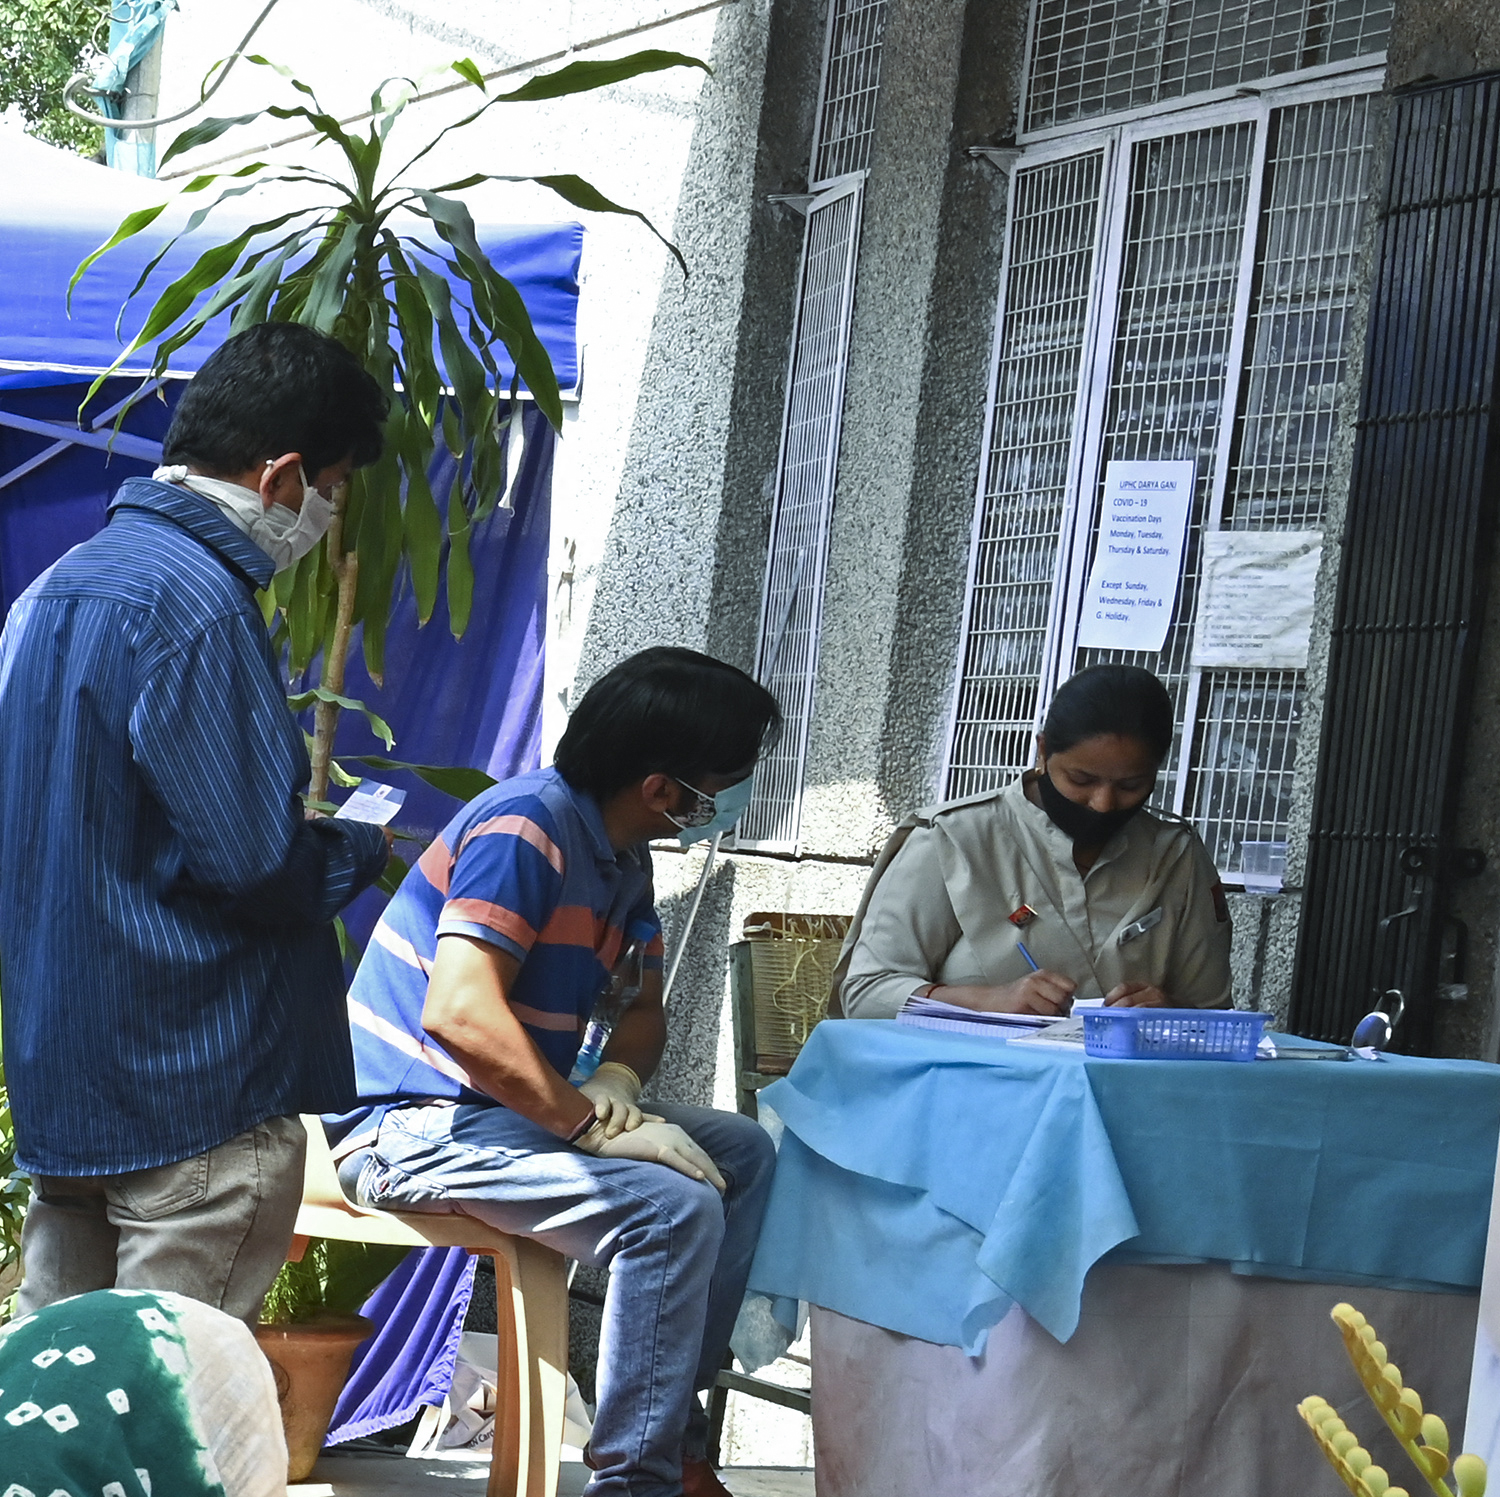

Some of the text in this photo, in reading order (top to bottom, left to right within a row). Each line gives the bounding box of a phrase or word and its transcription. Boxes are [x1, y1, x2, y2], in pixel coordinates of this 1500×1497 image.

[1119, 481, 1137, 489] UPHC
[1138, 481, 1159, 489] DARYA
[1112, 498, 1134, 507] COVID
[1140, 498, 1148, 507] 19
[1111, 514, 1162, 525] Vaccination Days
[1108, 545, 1135, 555] Thursday
[1136, 546, 1141, 554] &
[1101, 580, 1122, 591] Except
[1157, 599, 1163, 608] &
